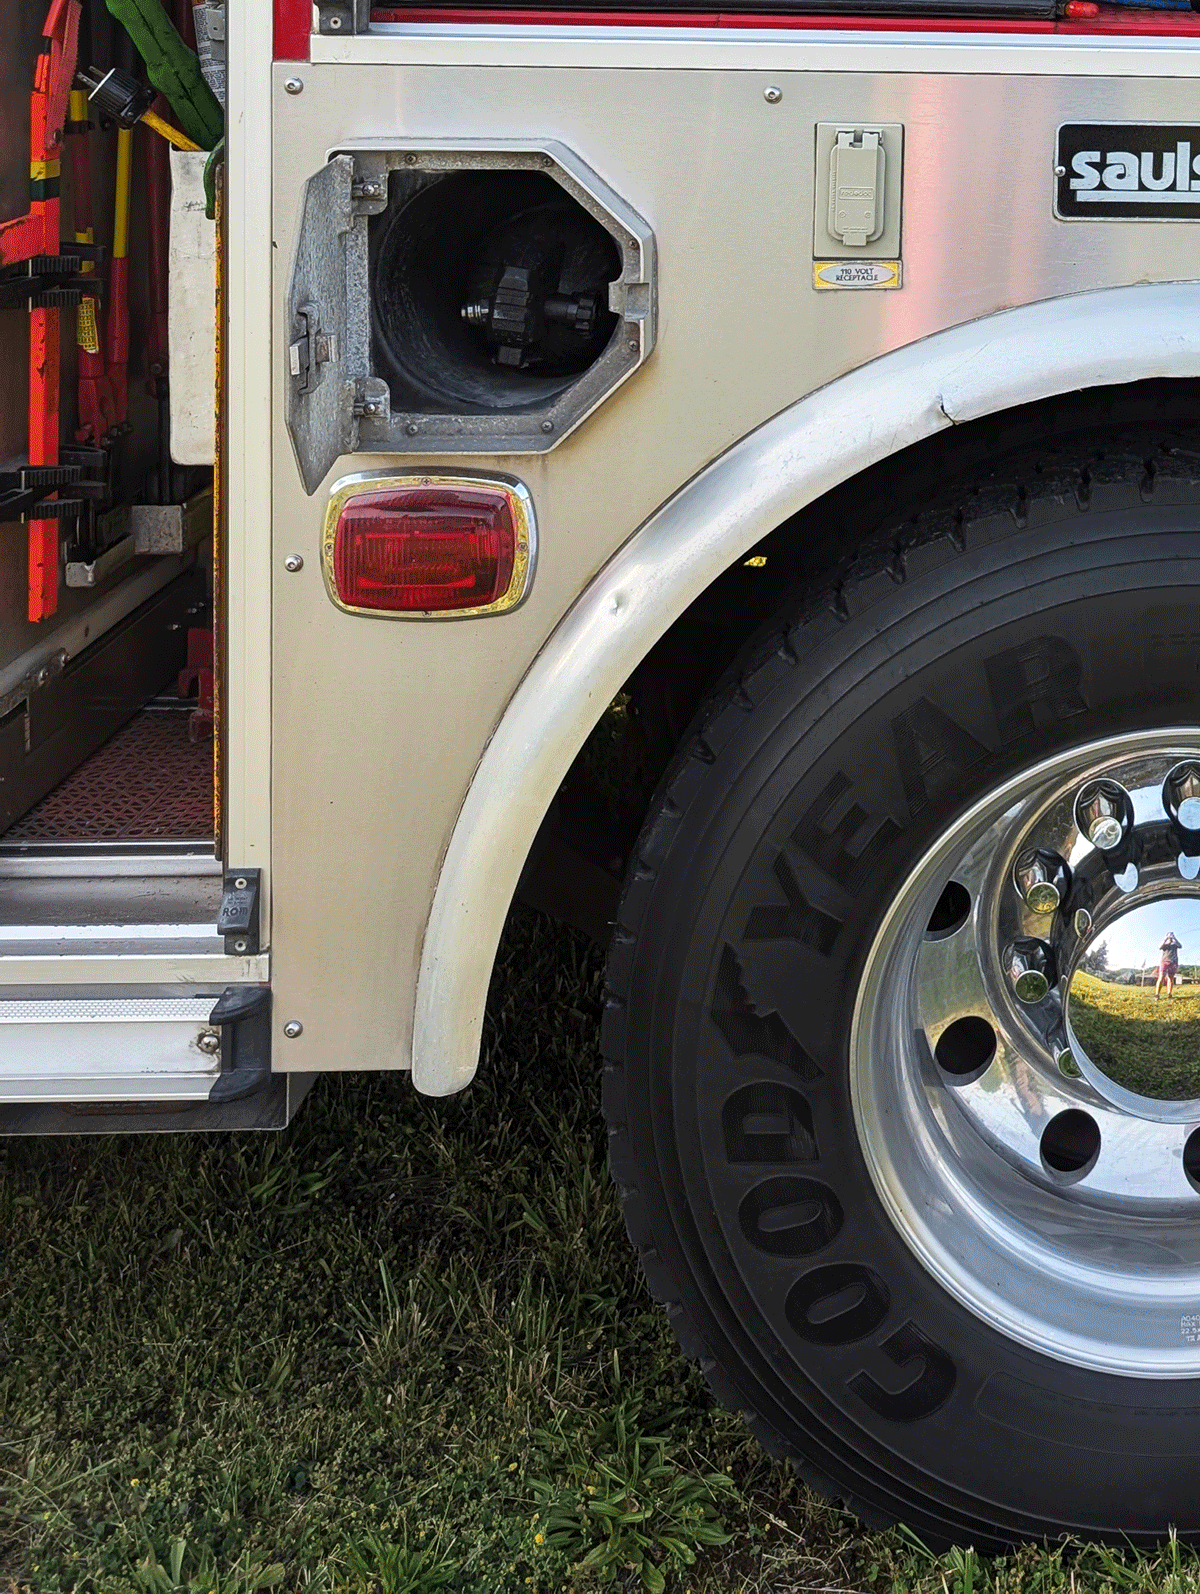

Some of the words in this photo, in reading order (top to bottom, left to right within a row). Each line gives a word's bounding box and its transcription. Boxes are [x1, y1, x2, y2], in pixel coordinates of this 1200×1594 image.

[854, 267, 875, 275] VOLT
[835, 273, 879, 282] RECEPTACLE
[712, 632, 1090, 1422] GOODYEAR
